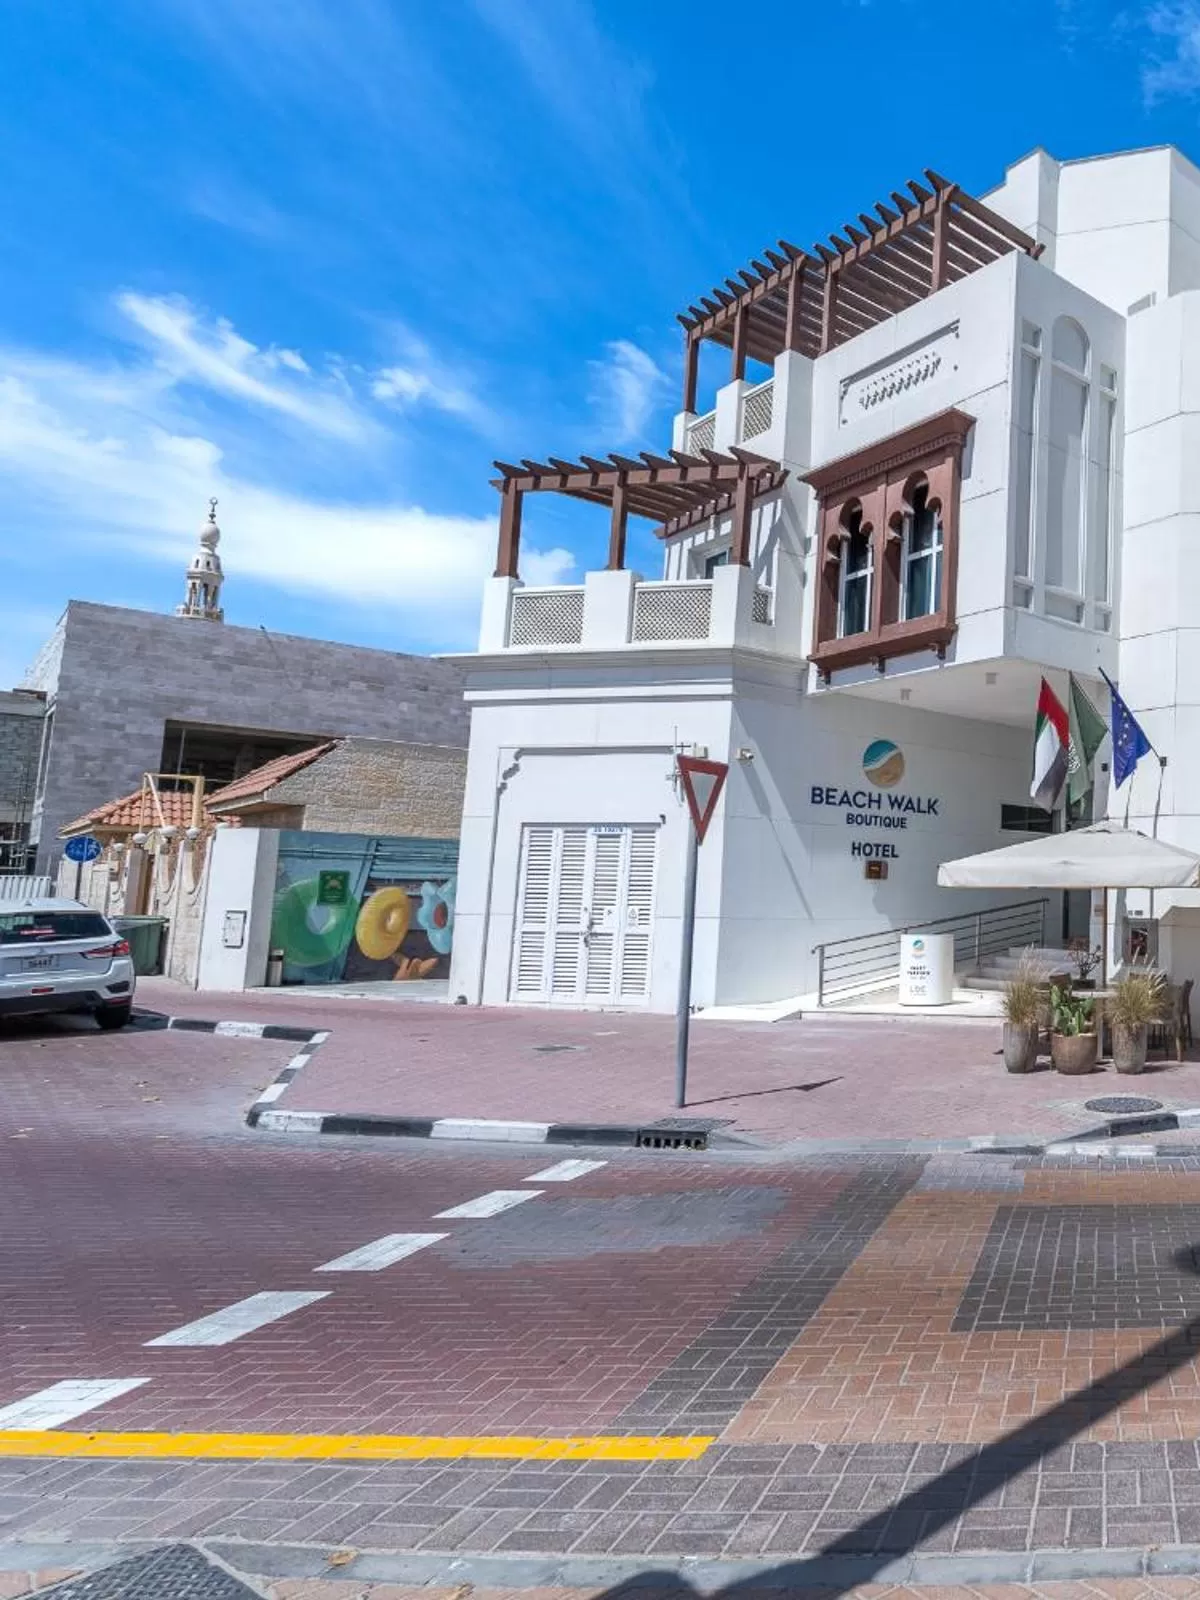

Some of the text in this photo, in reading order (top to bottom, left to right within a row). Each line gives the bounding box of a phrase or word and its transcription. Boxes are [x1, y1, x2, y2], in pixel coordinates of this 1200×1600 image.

[811, 786, 940, 815] BEACH WALK
[846, 812, 908, 829] BOUTIQUE
[851, 841, 900, 858] HOTEL
